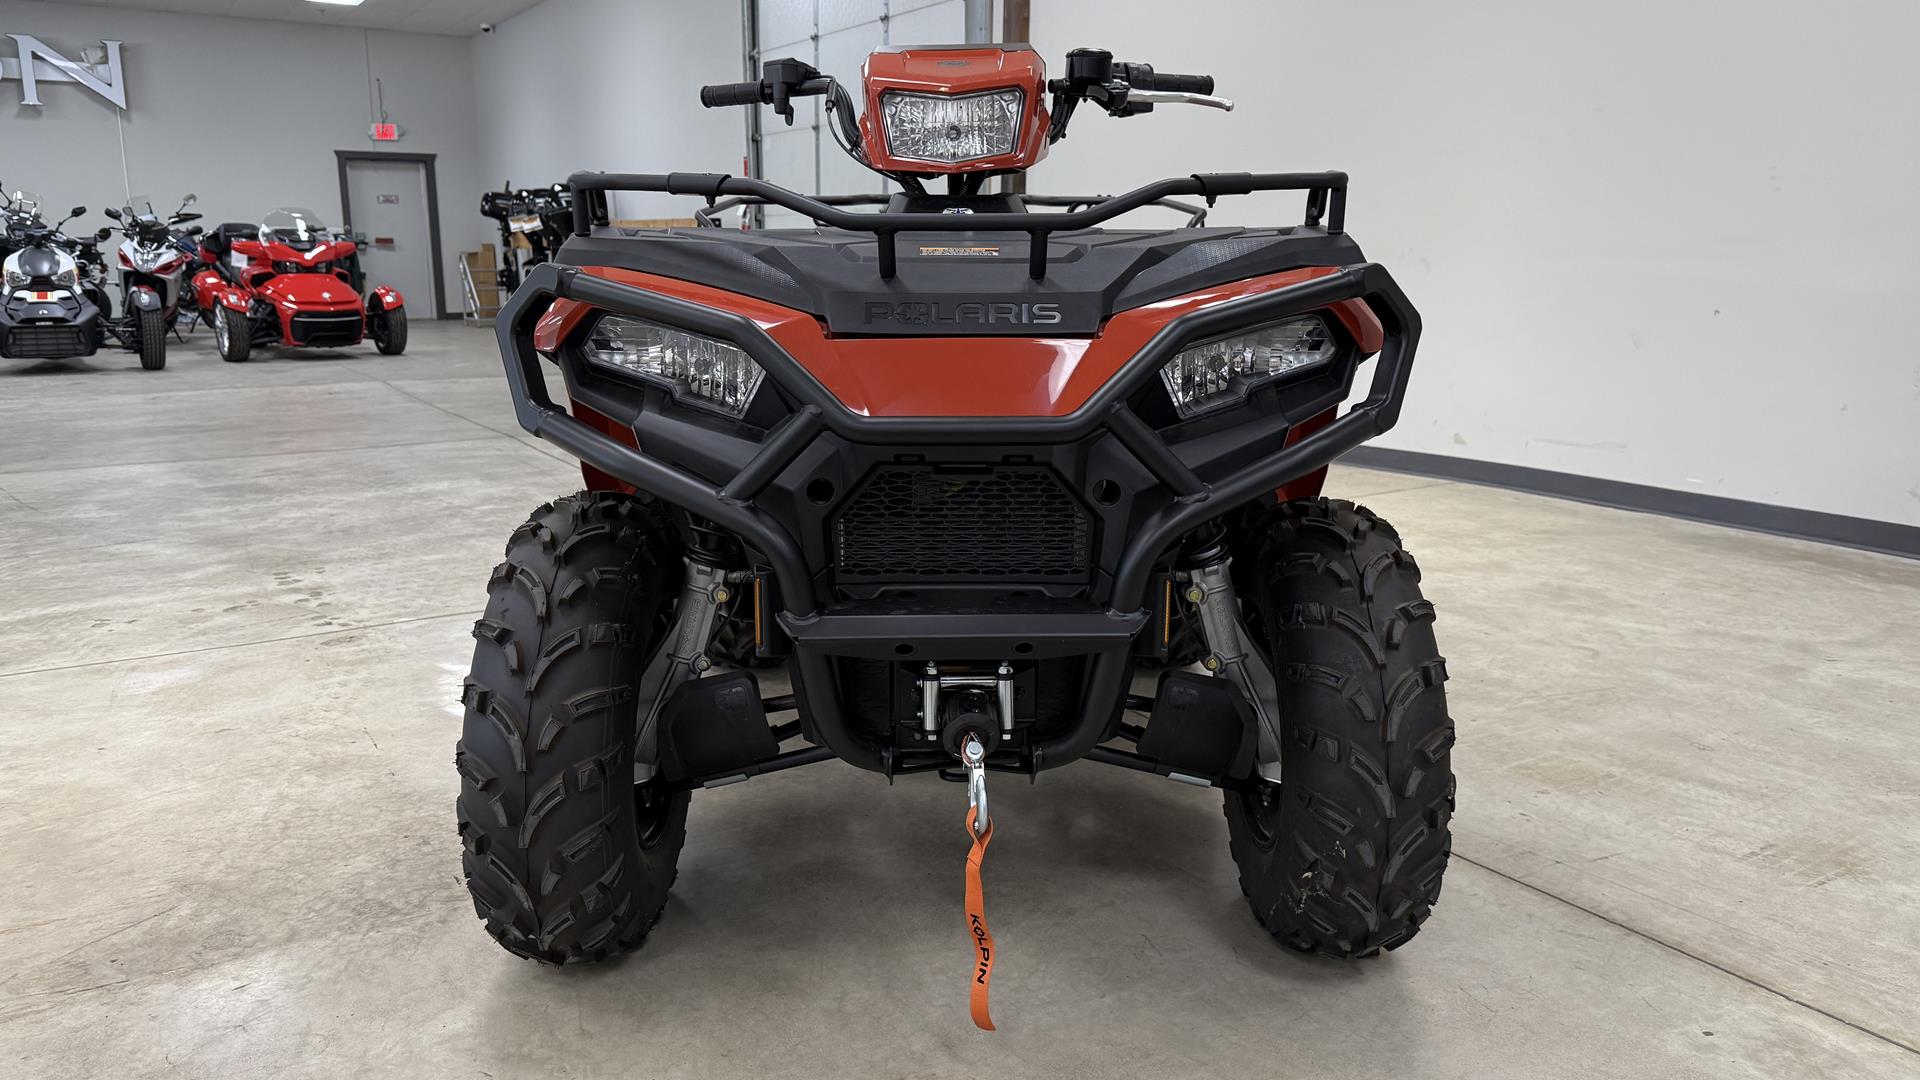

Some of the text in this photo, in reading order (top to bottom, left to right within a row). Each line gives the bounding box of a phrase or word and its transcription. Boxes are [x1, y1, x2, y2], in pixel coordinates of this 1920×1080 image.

[0, 33, 127, 110] N
[863, 302, 1062, 325] POLARIS
[970, 913, 990, 984] KOLPIN
